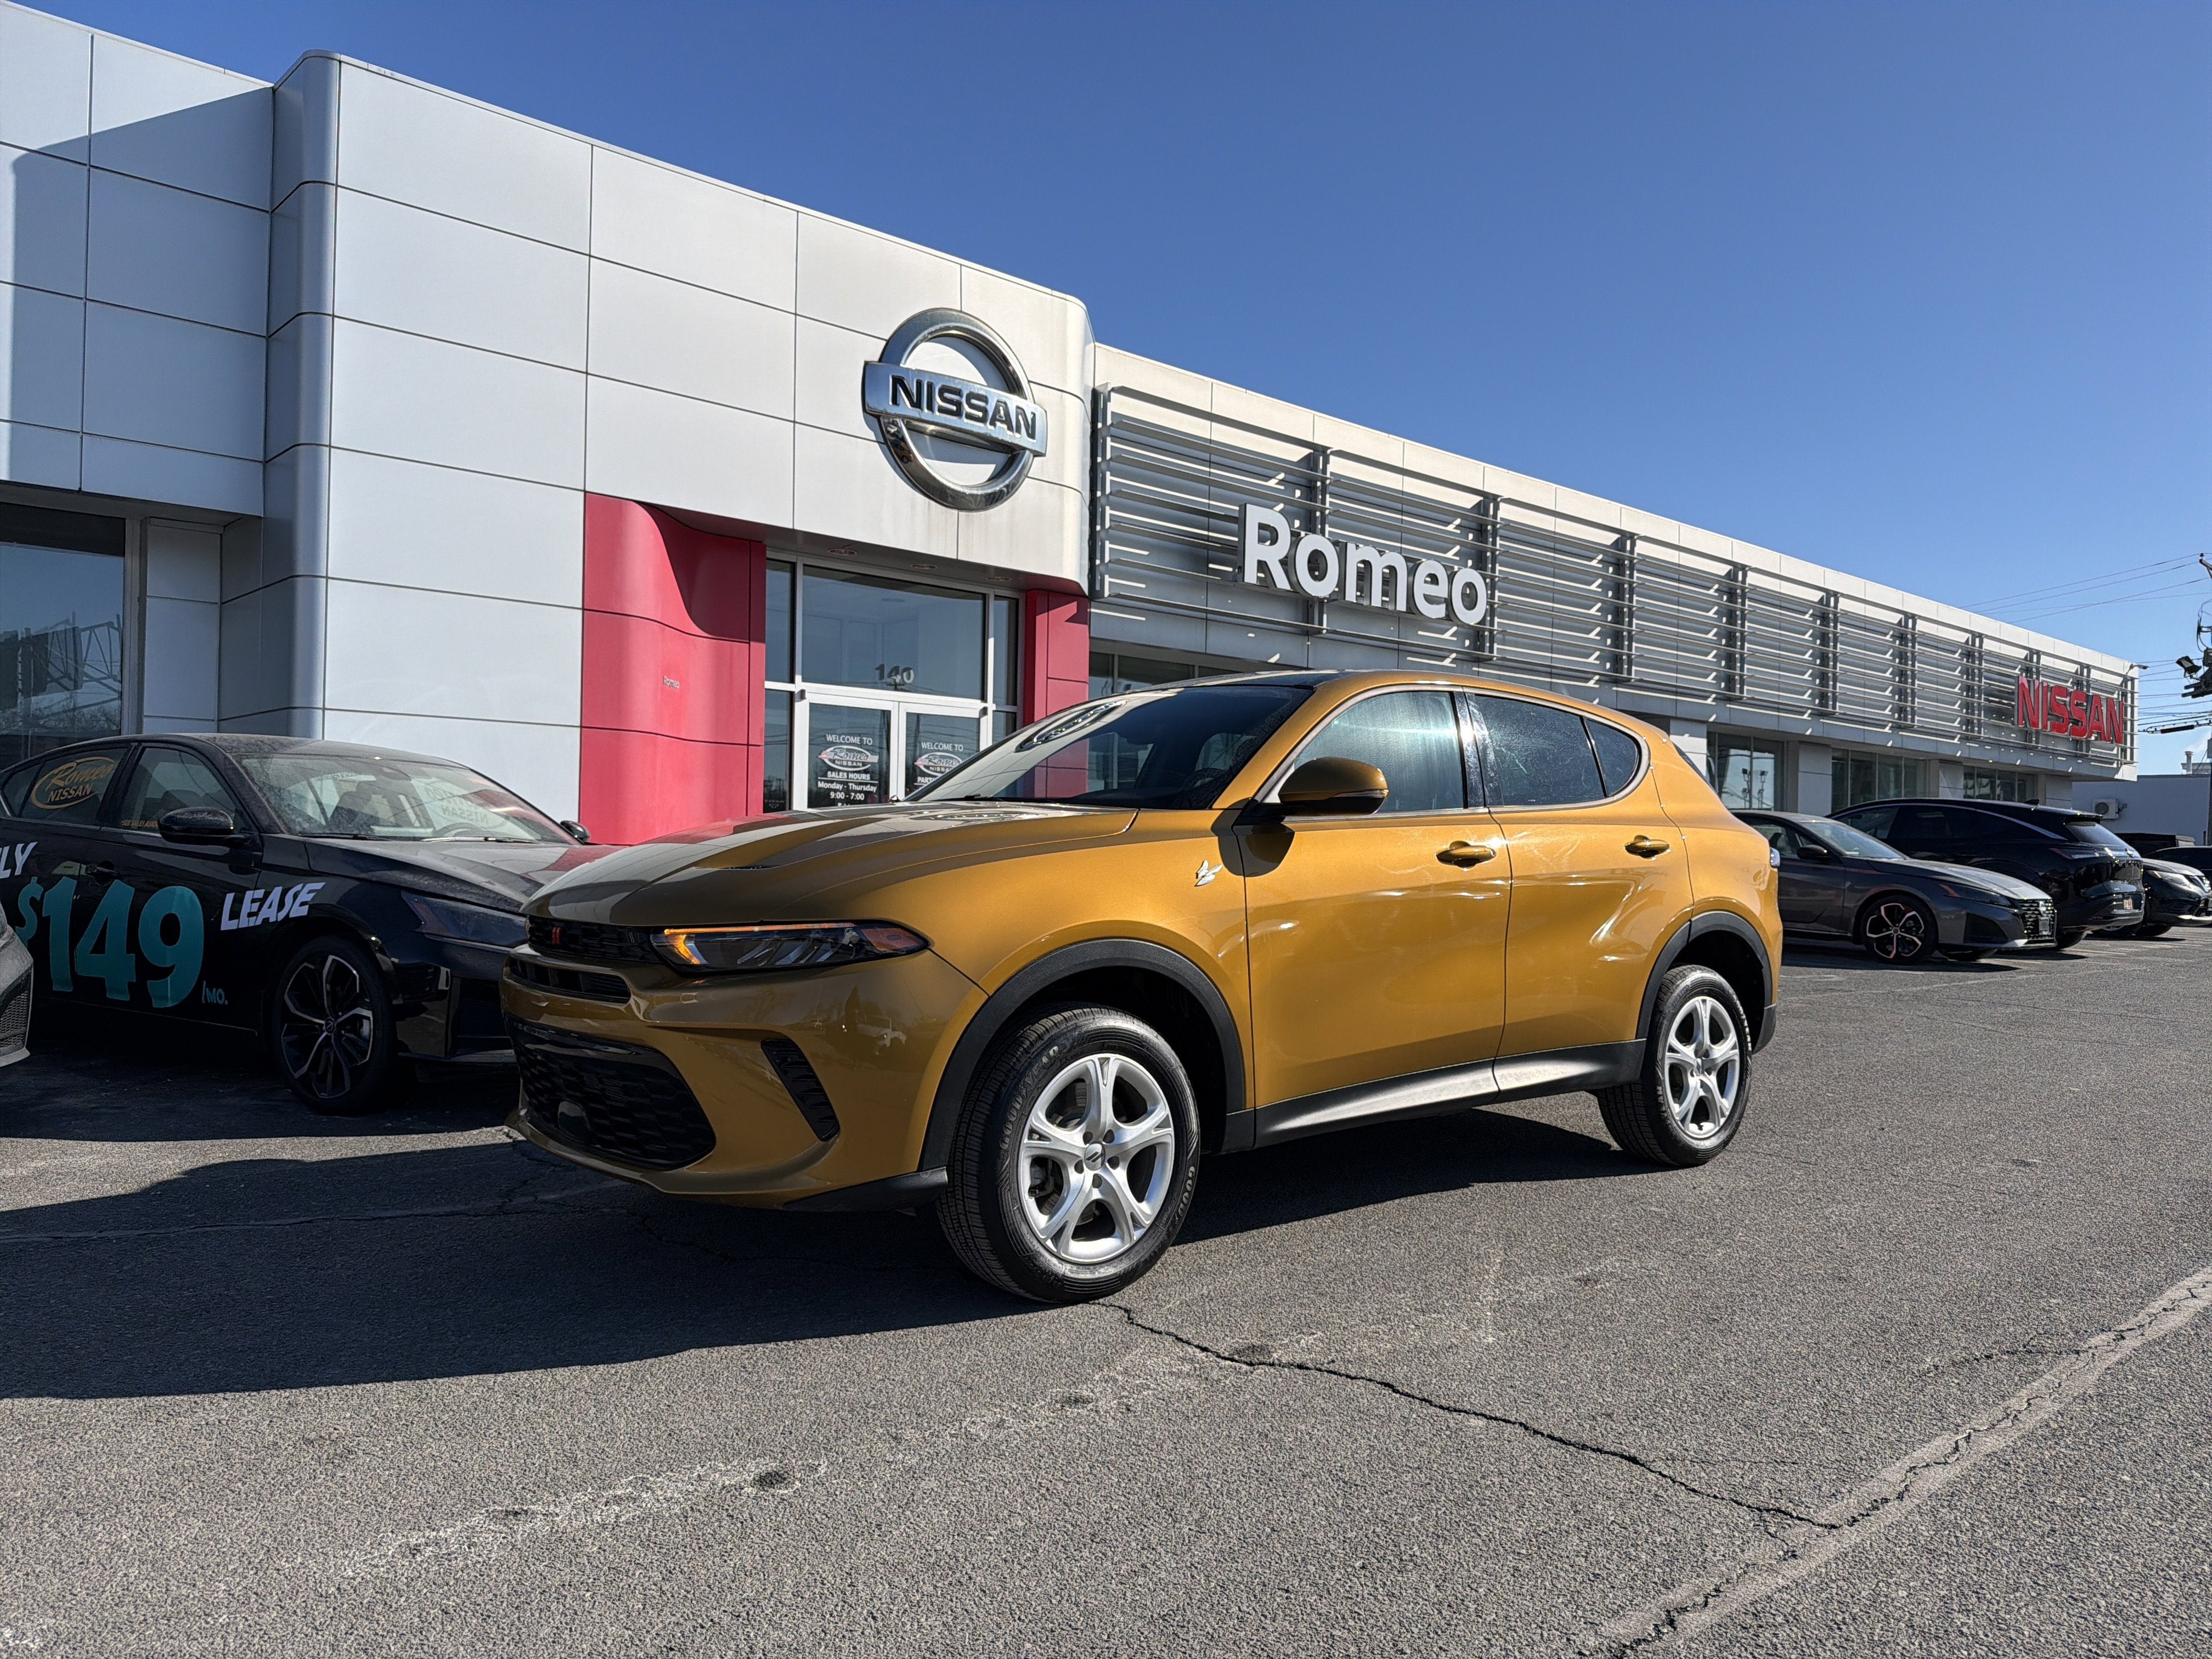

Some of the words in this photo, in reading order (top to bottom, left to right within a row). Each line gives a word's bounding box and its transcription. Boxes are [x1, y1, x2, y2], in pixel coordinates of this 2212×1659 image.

[889, 375, 1037, 443] NISSAN
[1239, 503, 1487, 624] Romeo
[874, 663, 915, 684] 140
[2017, 675, 2124, 744] NISSAN
[826, 734, 861, 744] WELCOME
[922, 742, 952, 751] WELCOME
[832, 747, 869, 761] Romeo
[46, 762, 115, 791] Romeo
[817, 781, 843, 791] Monday
[848, 783, 877, 793] Thursday
[47, 783, 93, 803] NISSAN
[850, 792, 865, 800] 7:00
[0, 842, 38, 878] LY
[220, 882, 326, 932] LEASE
[15, 876, 205, 1008] $149
